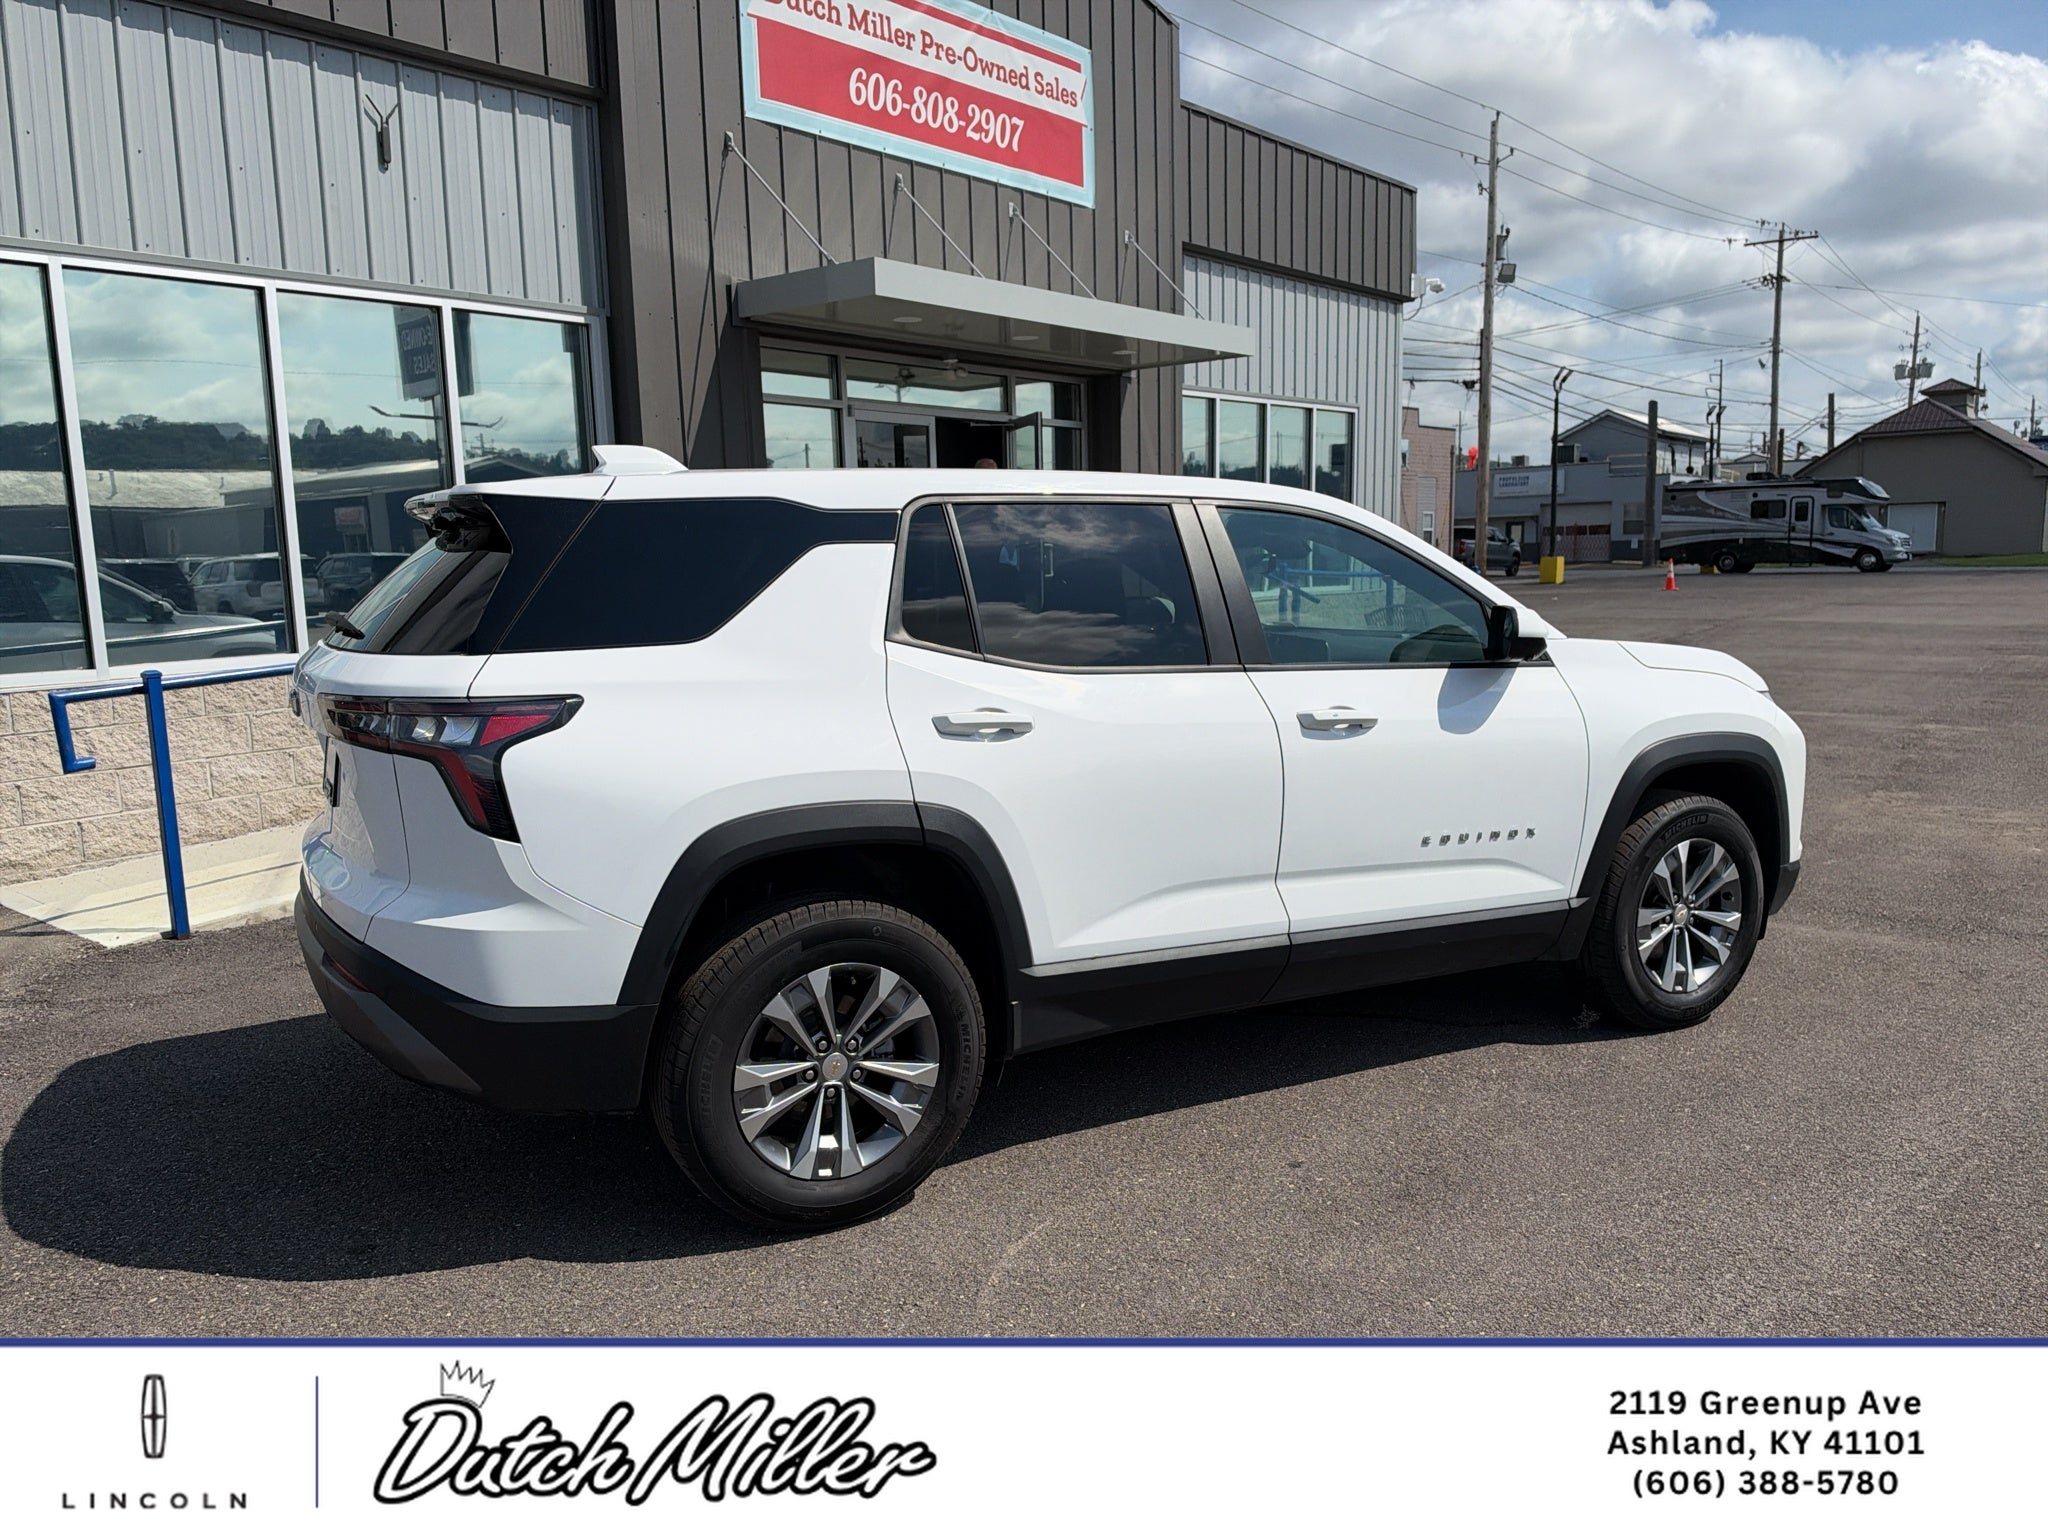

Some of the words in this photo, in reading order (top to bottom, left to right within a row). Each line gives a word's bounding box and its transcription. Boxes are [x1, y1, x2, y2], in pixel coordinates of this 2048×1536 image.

[764, 0, 842, 27] utch
[847, 3, 915, 51] Miller
[920, 29, 1030, 91] Pre-Owned
[1034, 71, 1078, 108] Sales
[849, 67, 1025, 152] 606-808-2907
[1420, 827, 1536, 848] EQUINOX
[1664, 814, 1708, 840] MICHELIN
[954, 1023, 972, 1102] MICHELIN
